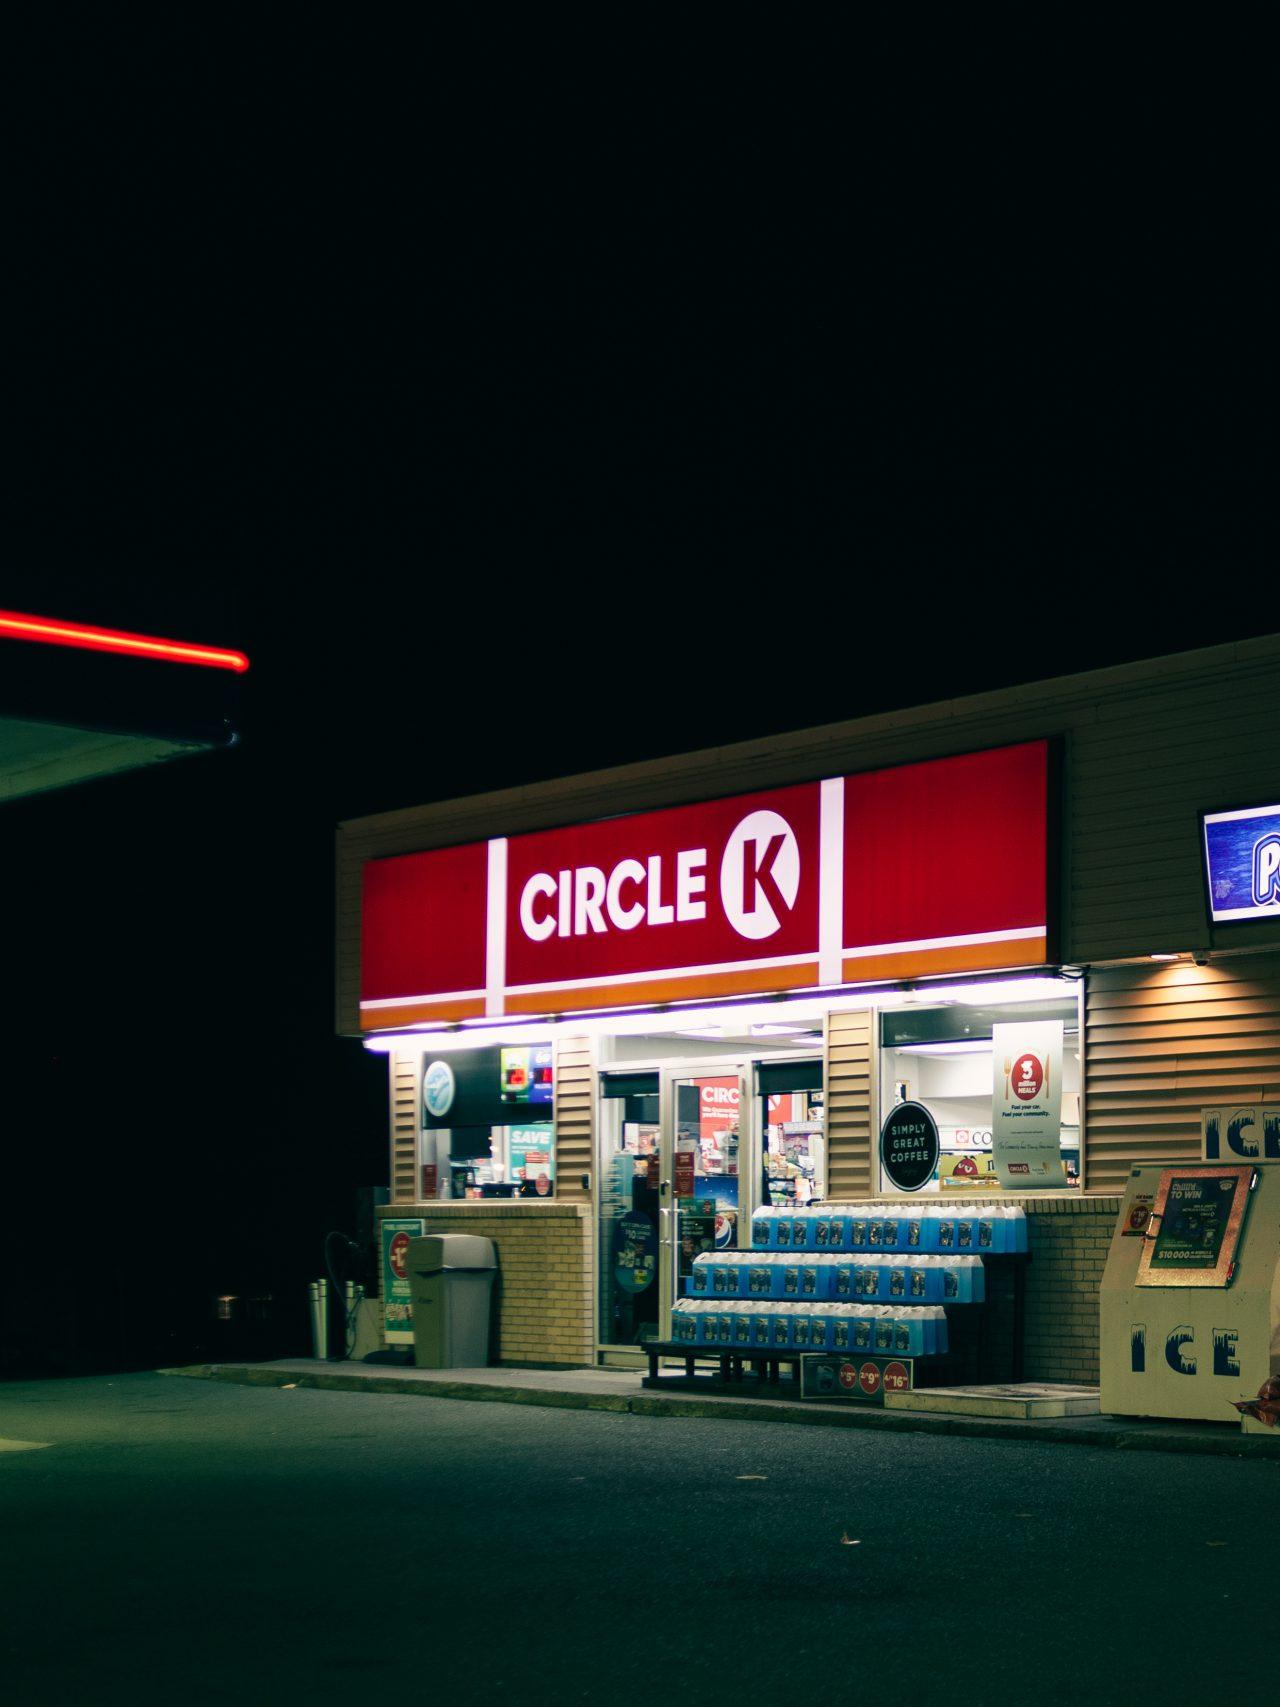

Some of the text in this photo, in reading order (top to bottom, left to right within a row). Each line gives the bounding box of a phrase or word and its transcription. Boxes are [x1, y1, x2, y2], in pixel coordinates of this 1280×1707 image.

[519, 808, 797, 942] CIRCLE K
[891, 1123, 926, 1136] SIMPLY
[511, 1130, 551, 1145] SAVE
[893, 1137, 925, 1149] GREAT
[890, 1150, 929, 1163] COFFEE
[1171, 1190, 1202, 1199] TO WIN
[1130, 1322, 1241, 1377] ICE
